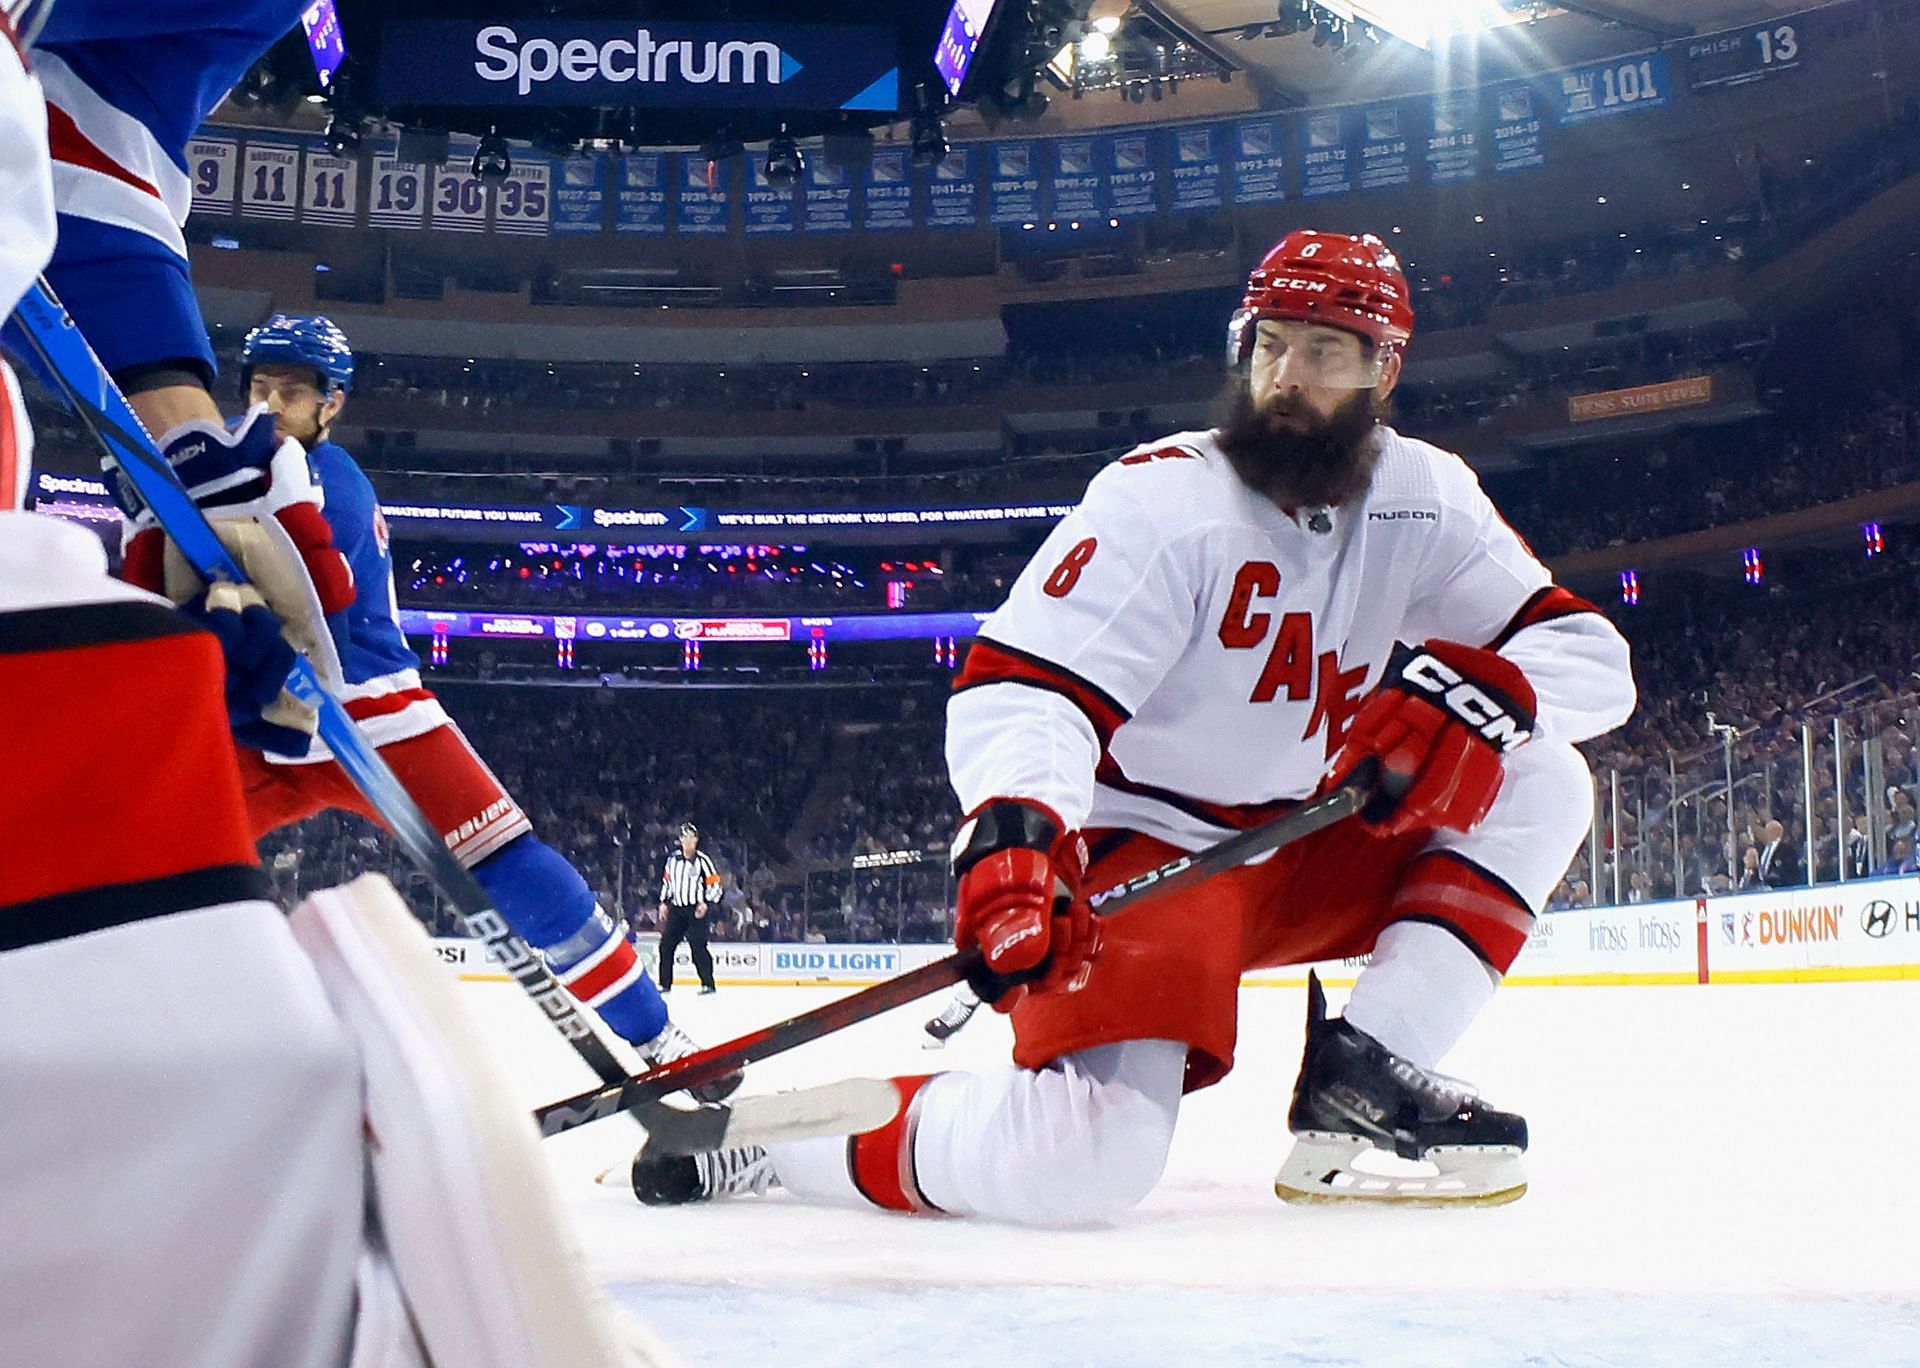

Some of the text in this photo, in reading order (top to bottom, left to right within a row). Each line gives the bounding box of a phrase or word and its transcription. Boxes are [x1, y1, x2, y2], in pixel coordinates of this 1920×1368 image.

[474, 25, 780, 94] Spectrum
[1689, 26, 1798, 64] PHISH 13
[1603, 61, 1657, 106] 101
[196, 159, 219, 196] 9
[253, 165, 286, 202] 11
[312, 171, 346, 209] 11
[377, 174, 417, 211] 19
[437, 177, 483, 214] 30
[500, 180, 547, 218] 35
[1272, 277, 1327, 293] CCM
[1663, 385, 1706, 402] LEVEL
[380, 506, 440, 519] WHATEVER
[440, 508, 482, 520] FUTURE
[483, 509, 507, 521] YOU
[593, 507, 664, 526] Spectrum
[754, 514, 785, 525] BUILT
[786, 514, 808, 524] THE
[808, 513, 862, 524] NETWORK
[863, 513, 887, 523] YOU
[920, 511, 944, 522] FOR
[944, 509, 1003, 521] WHATEVER
[1004, 507, 1048, 519] FUTURE
[1048, 505, 1072, 517] YOU
[1042, 537, 1098, 599] 8
[1402, 653, 1533, 752] CCM
[444, 798, 512, 850] BAUER
[991, 923, 1043, 960] CCM
[1588, 920, 1628, 954] Infosys
[1638, 915, 1681, 953] Infosys
[1759, 904, 1844, 946] DUNKIN'
[463, 908, 592, 1041] BAUER
[776, 953, 896, 970] BUD LIGHT
